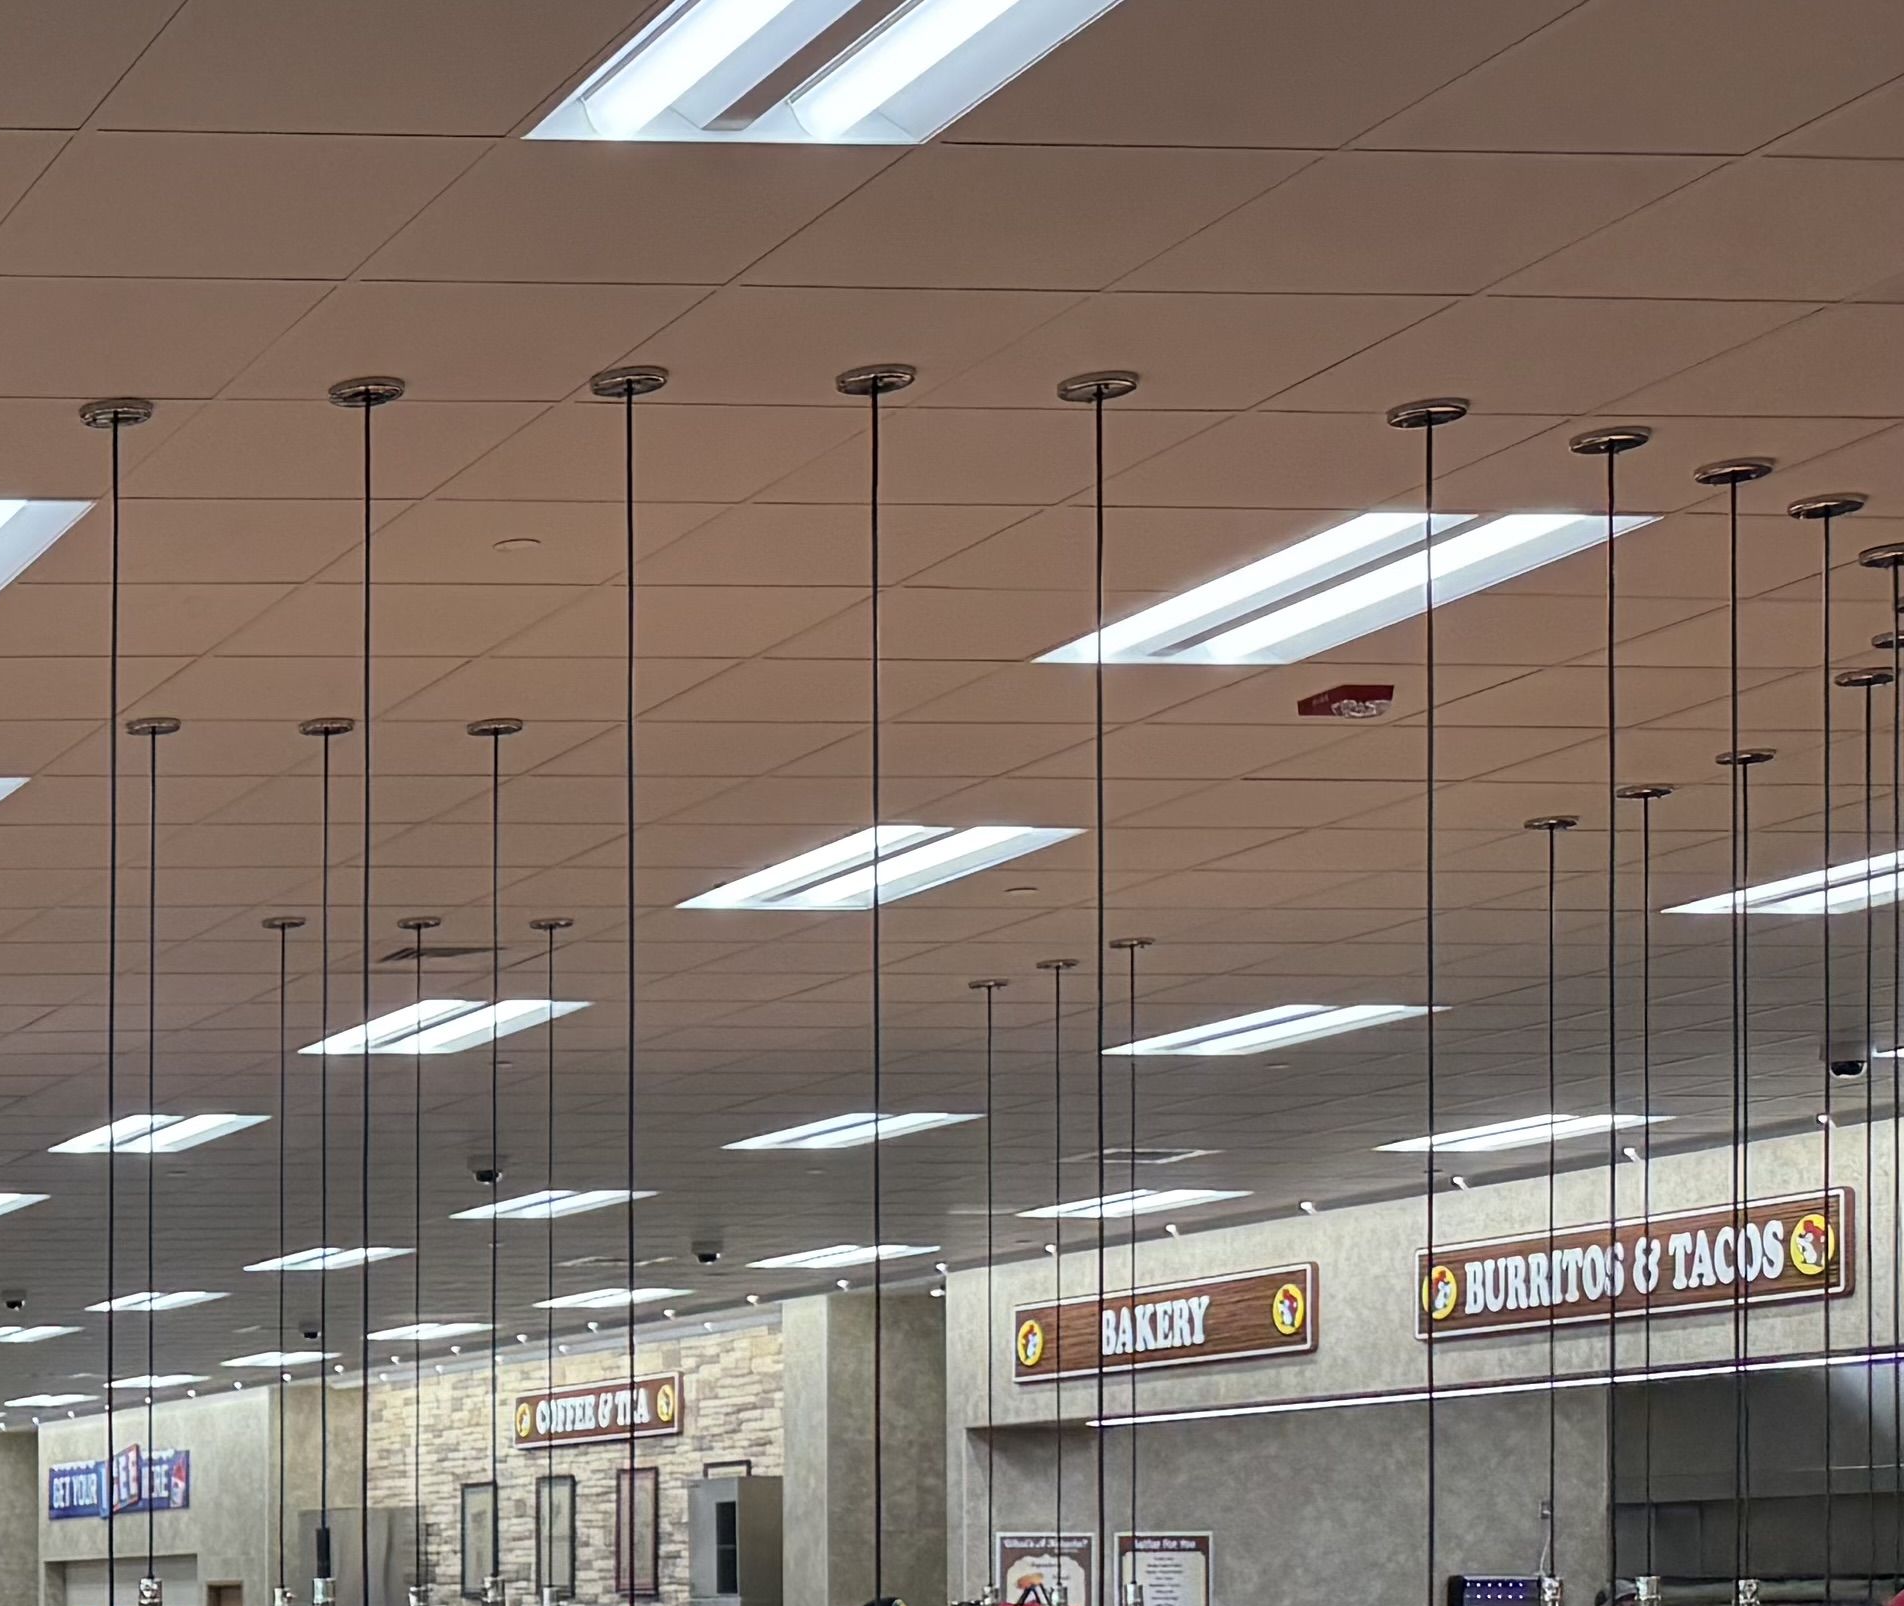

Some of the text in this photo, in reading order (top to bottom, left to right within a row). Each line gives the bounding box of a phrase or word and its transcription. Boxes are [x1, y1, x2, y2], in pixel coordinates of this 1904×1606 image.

[1464, 1219, 1785, 1315] BURRITOS & TACOS
[1101, 1294, 1210, 1356] BAKERY
[535, 1394, 596, 1436] COFFEE
[614, 1387, 650, 1427] TEA
